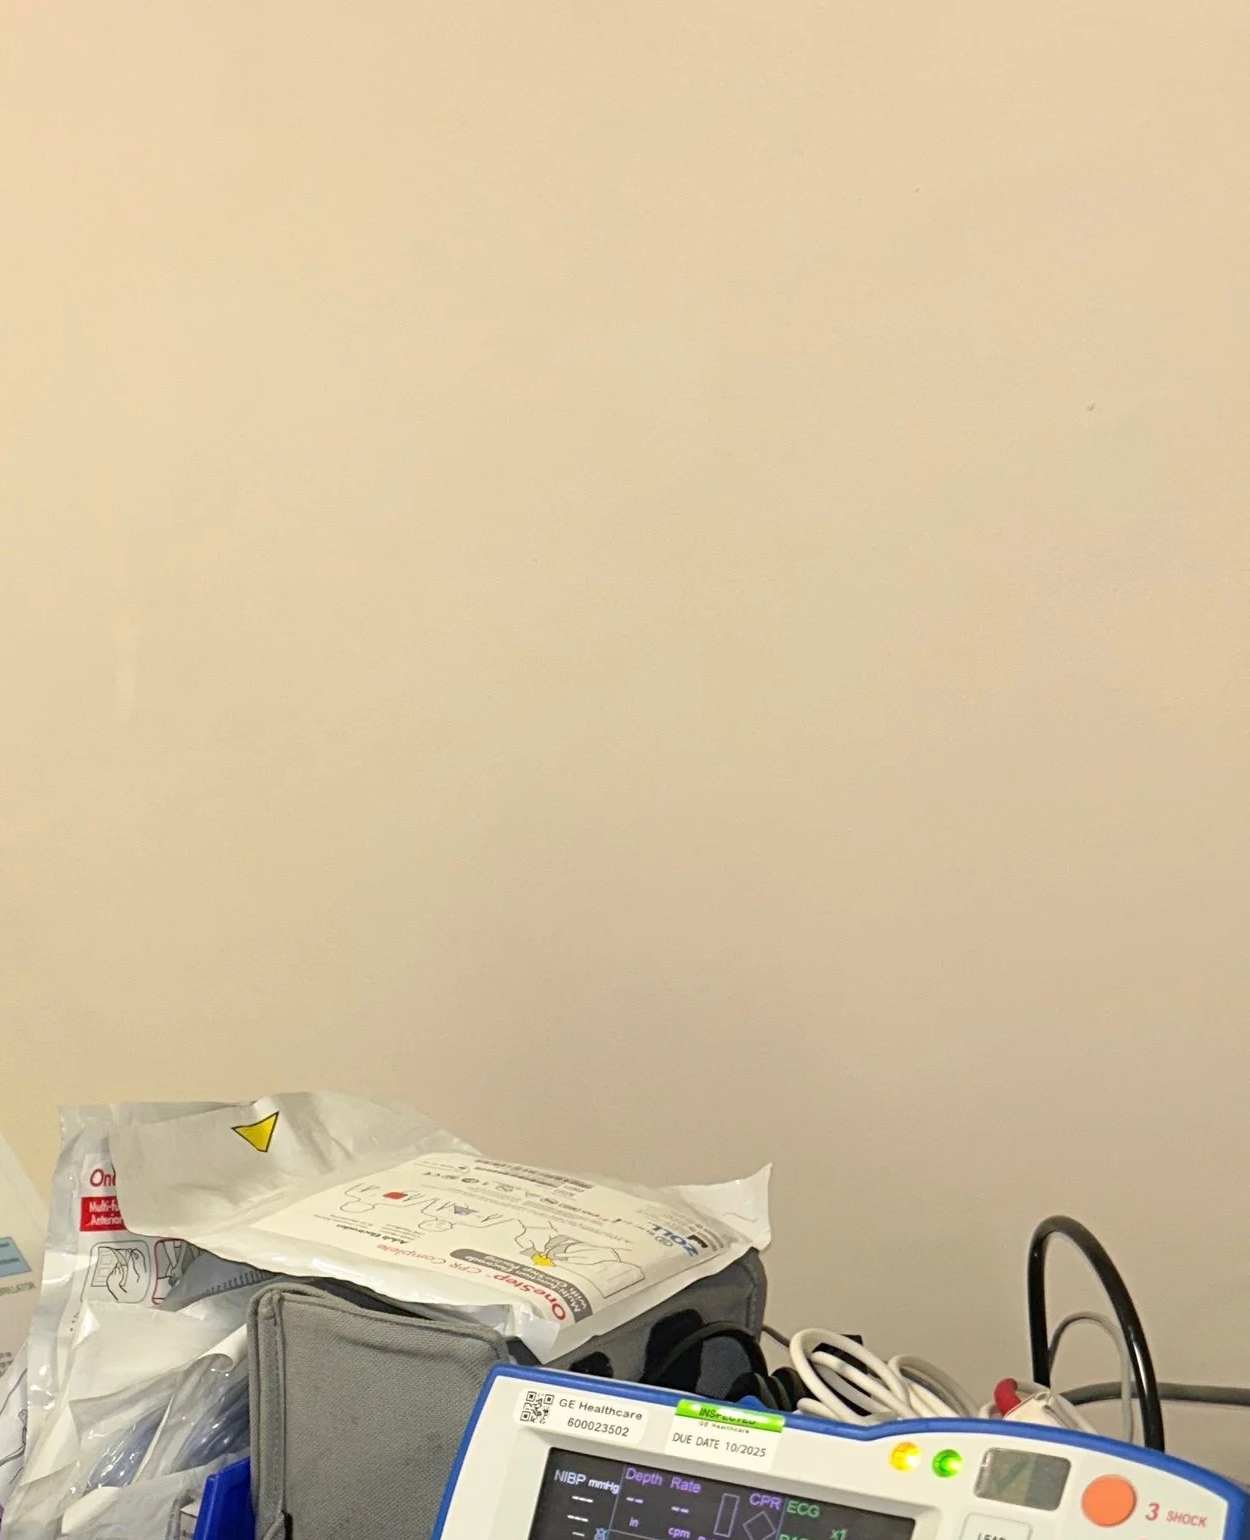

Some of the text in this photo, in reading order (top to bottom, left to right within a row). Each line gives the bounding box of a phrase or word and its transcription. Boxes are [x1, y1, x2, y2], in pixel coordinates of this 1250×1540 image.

[376, 1244, 566, 1321] OneStep CPR Complete
[558, 1398, 643, 1421] GE Healthcare
[566, 1417, 630, 1438] 600023502
[672, 1432, 767, 1458] DUE DATE 10/2025
[554, 1469, 621, 1495] NIBP mmHg
[625, 1468, 702, 1494] Depth Rate
[750, 1493, 821, 1518] CPR ECG
[1145, 1502, 1208, 1528] 3 SHOCK
[628, 1516, 639, 1528] in
